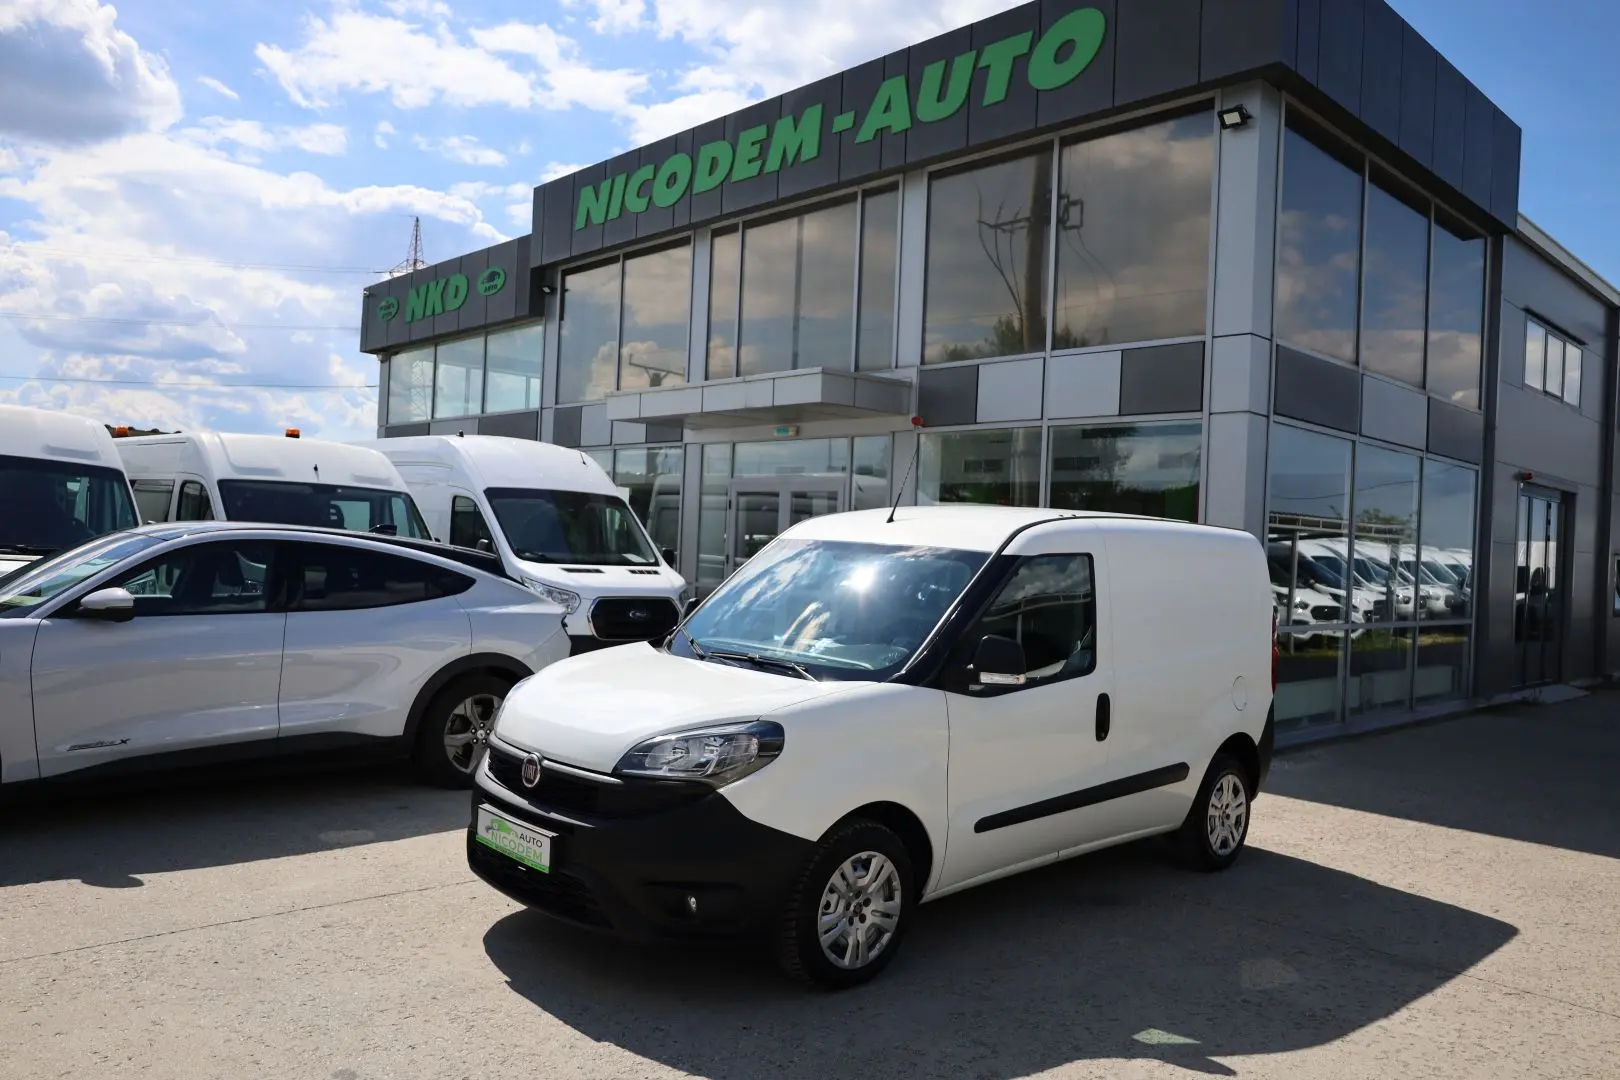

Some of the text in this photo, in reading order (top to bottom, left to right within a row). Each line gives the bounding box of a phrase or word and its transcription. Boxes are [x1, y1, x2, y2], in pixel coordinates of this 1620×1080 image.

[405, 273, 469, 324] NKD
[490, 830, 543, 863] NICODEM
[519, 833, 543, 848] AUTO
